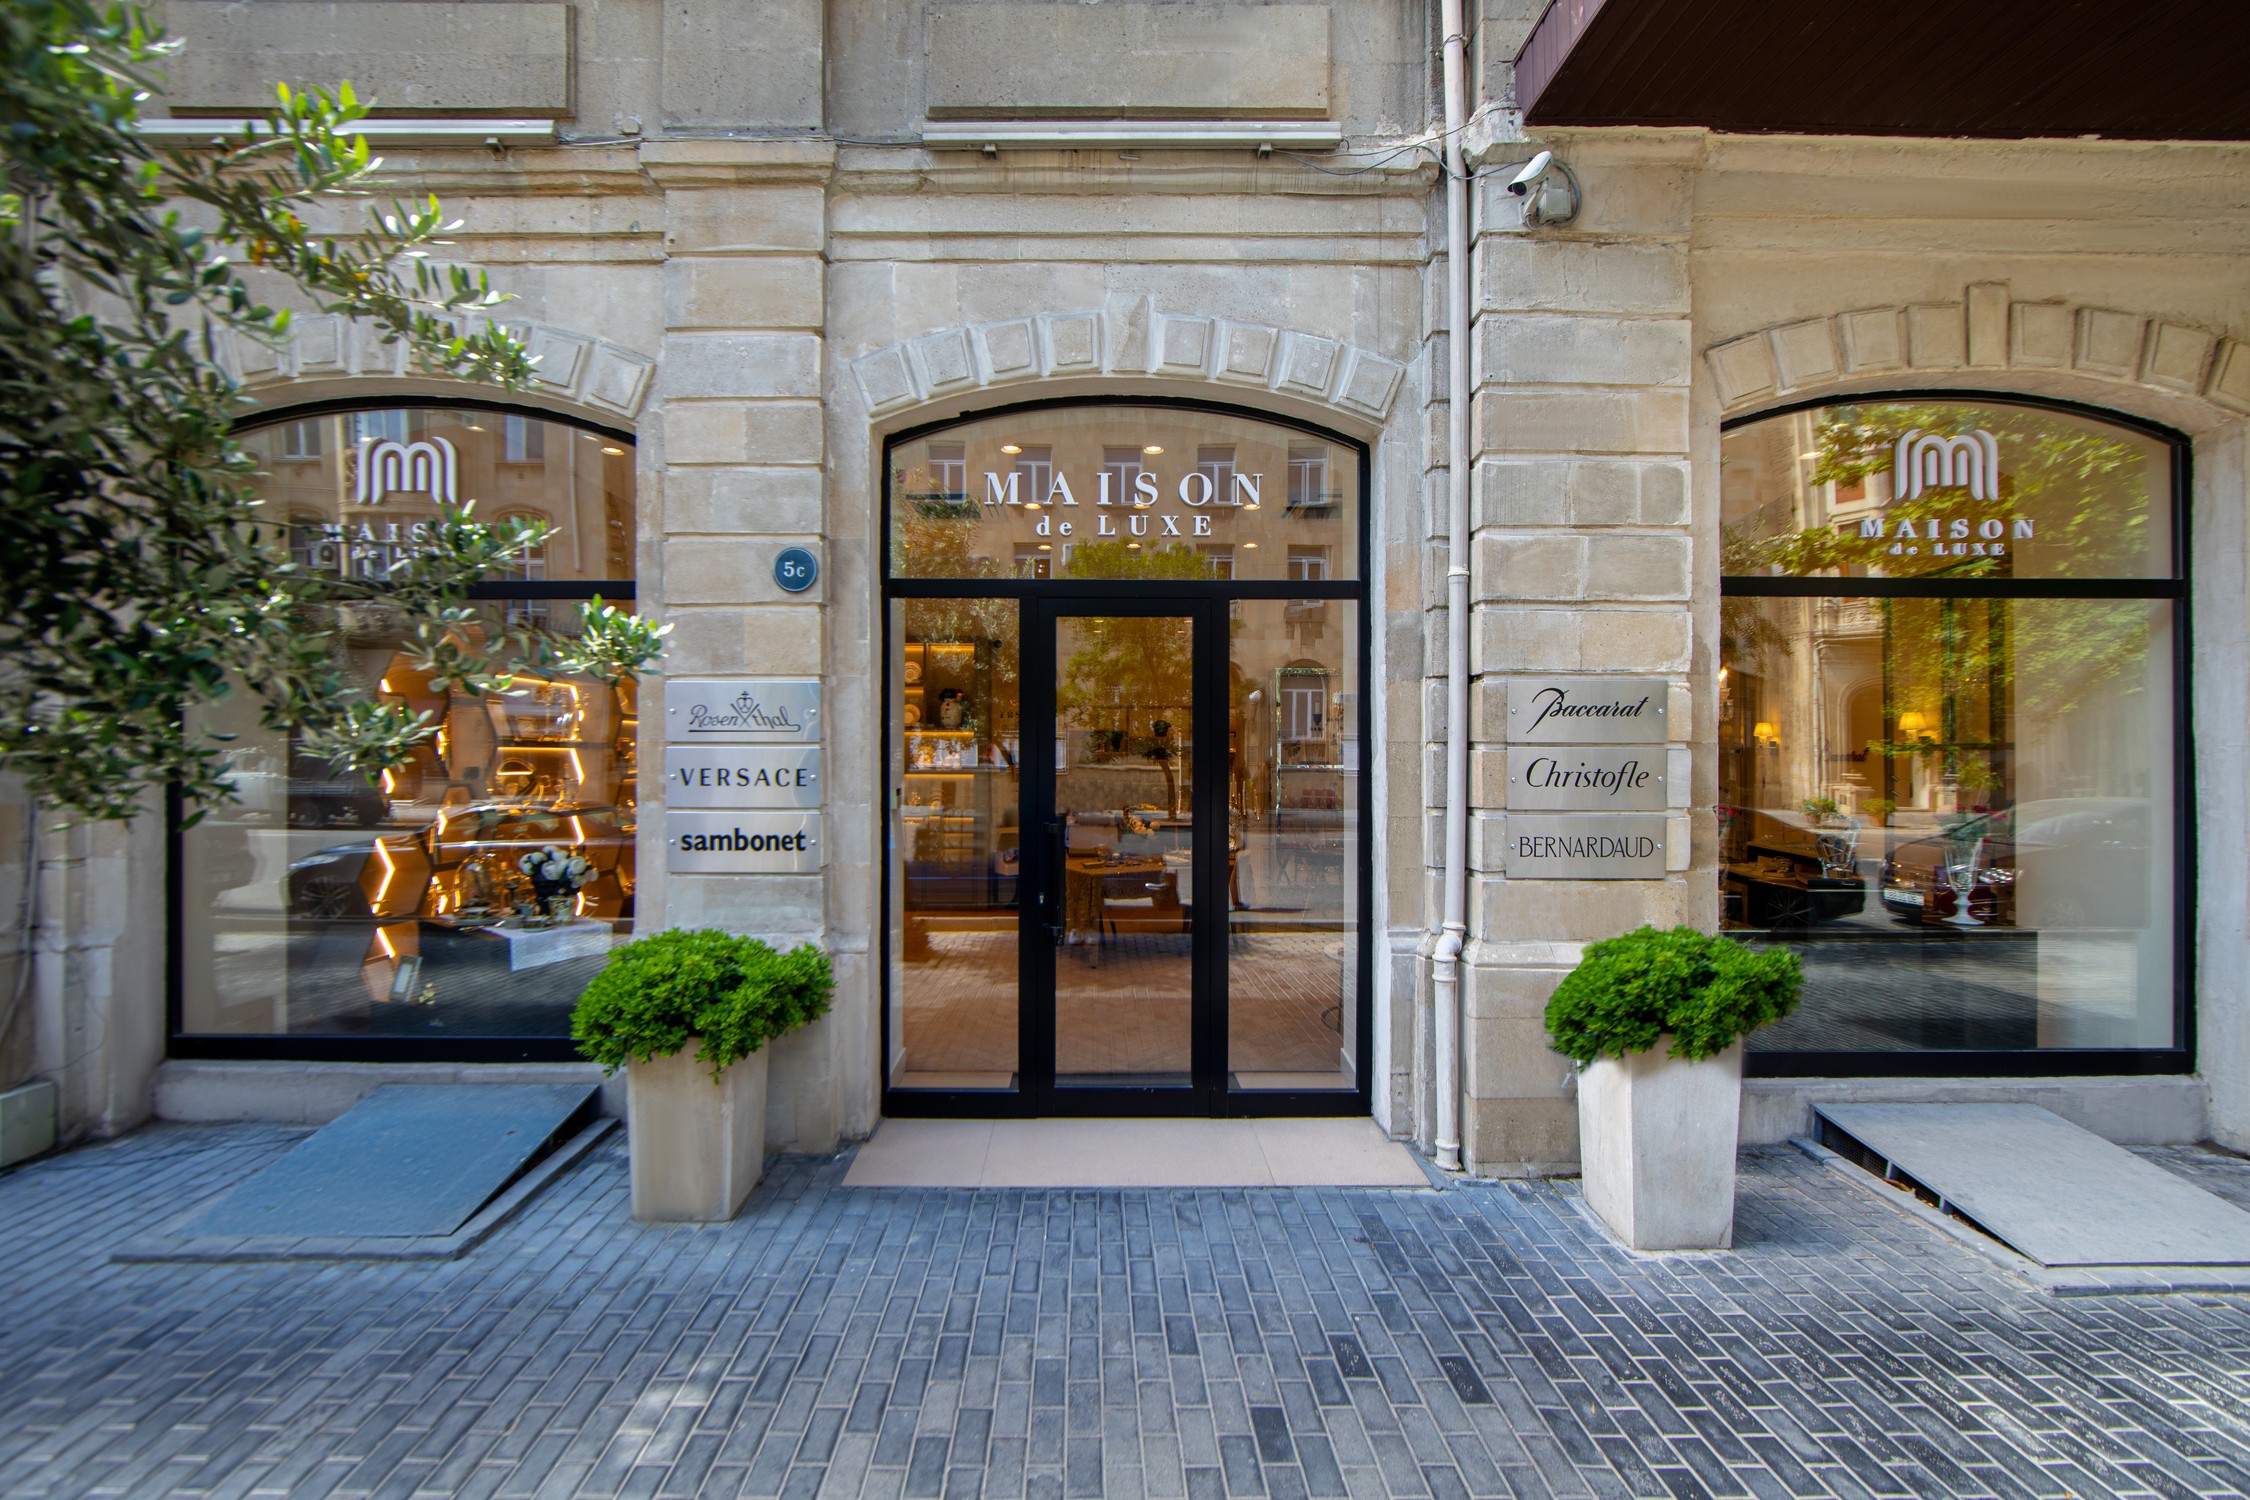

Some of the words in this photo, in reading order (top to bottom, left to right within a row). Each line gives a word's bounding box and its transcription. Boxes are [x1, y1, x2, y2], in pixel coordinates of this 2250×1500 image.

[983, 471, 1264, 507] MAISON
[1036, 515, 1073, 537] de
[1097, 515, 1213, 537] LUXE
[1858, 518, 2035, 540] MAISON
[1889, 543, 1919, 556] de
[1933, 543, 2006, 557] LUXE
[688, 700, 802, 733] Rosenthal
[1526, 687, 1650, 735] Baccarat
[680, 767, 808, 787] VERSACE
[1526, 757, 1650, 796] Christofle
[680, 828, 807, 852] sambonet
[1519, 836, 1655, 858] BERNARDAUD
